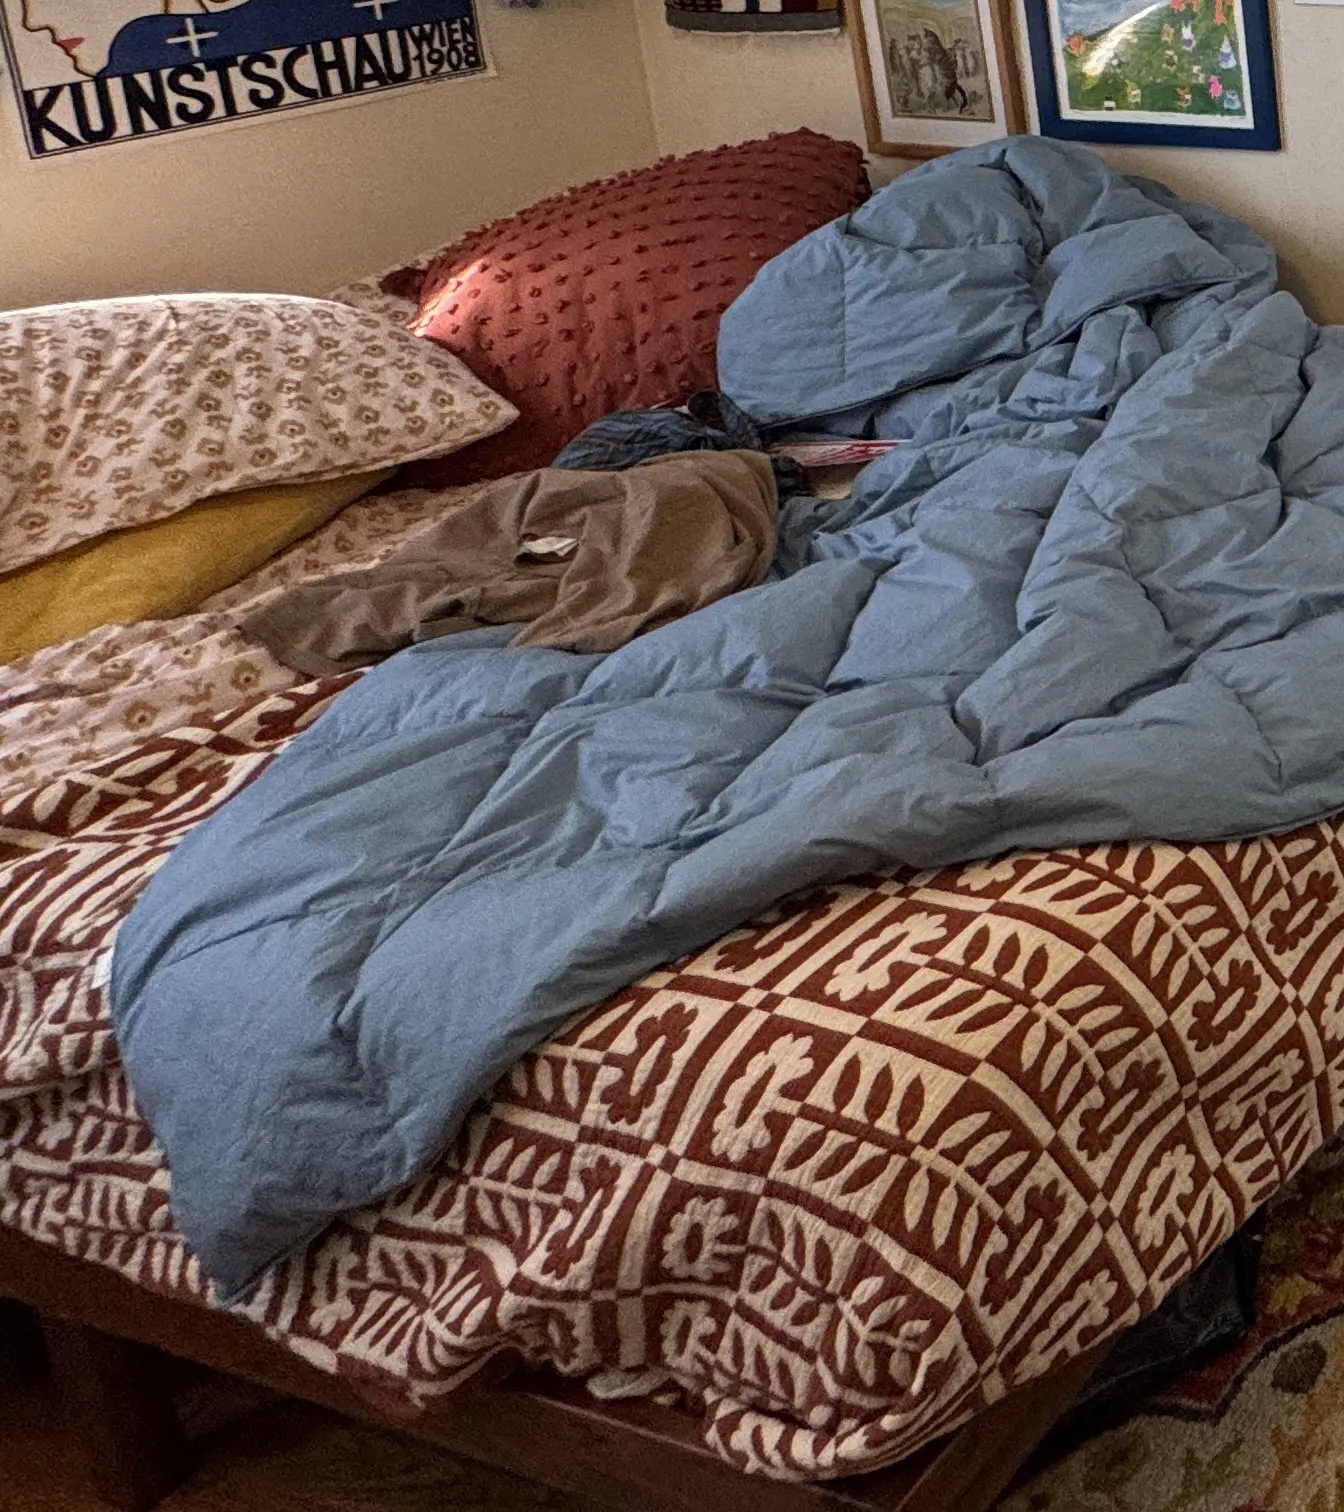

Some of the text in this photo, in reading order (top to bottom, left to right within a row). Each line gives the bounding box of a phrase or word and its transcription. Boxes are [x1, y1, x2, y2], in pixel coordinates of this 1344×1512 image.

[23, 15, 476, 156] KUNSTSCHAU WIEN
[412, 40, 481, 79] 1908
